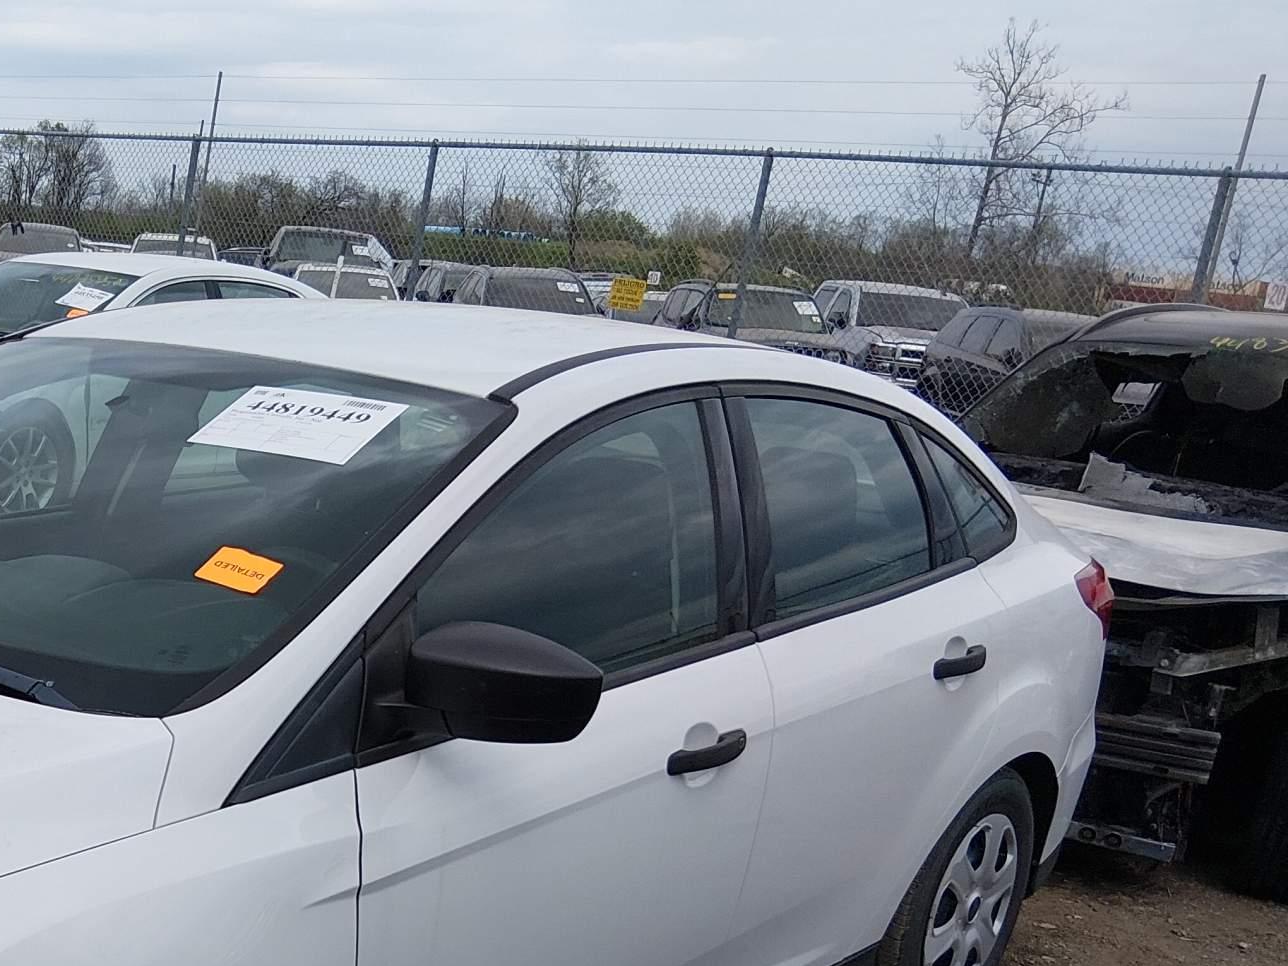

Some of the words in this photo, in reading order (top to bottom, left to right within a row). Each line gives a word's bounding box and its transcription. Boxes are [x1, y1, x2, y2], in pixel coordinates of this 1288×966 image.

[1124, 271, 1165, 284] Matson
[1268, 283, 1286, 306] 20
[247, 400, 372, 425] 44819449
[214, 560, 265, 580] DETAILED
